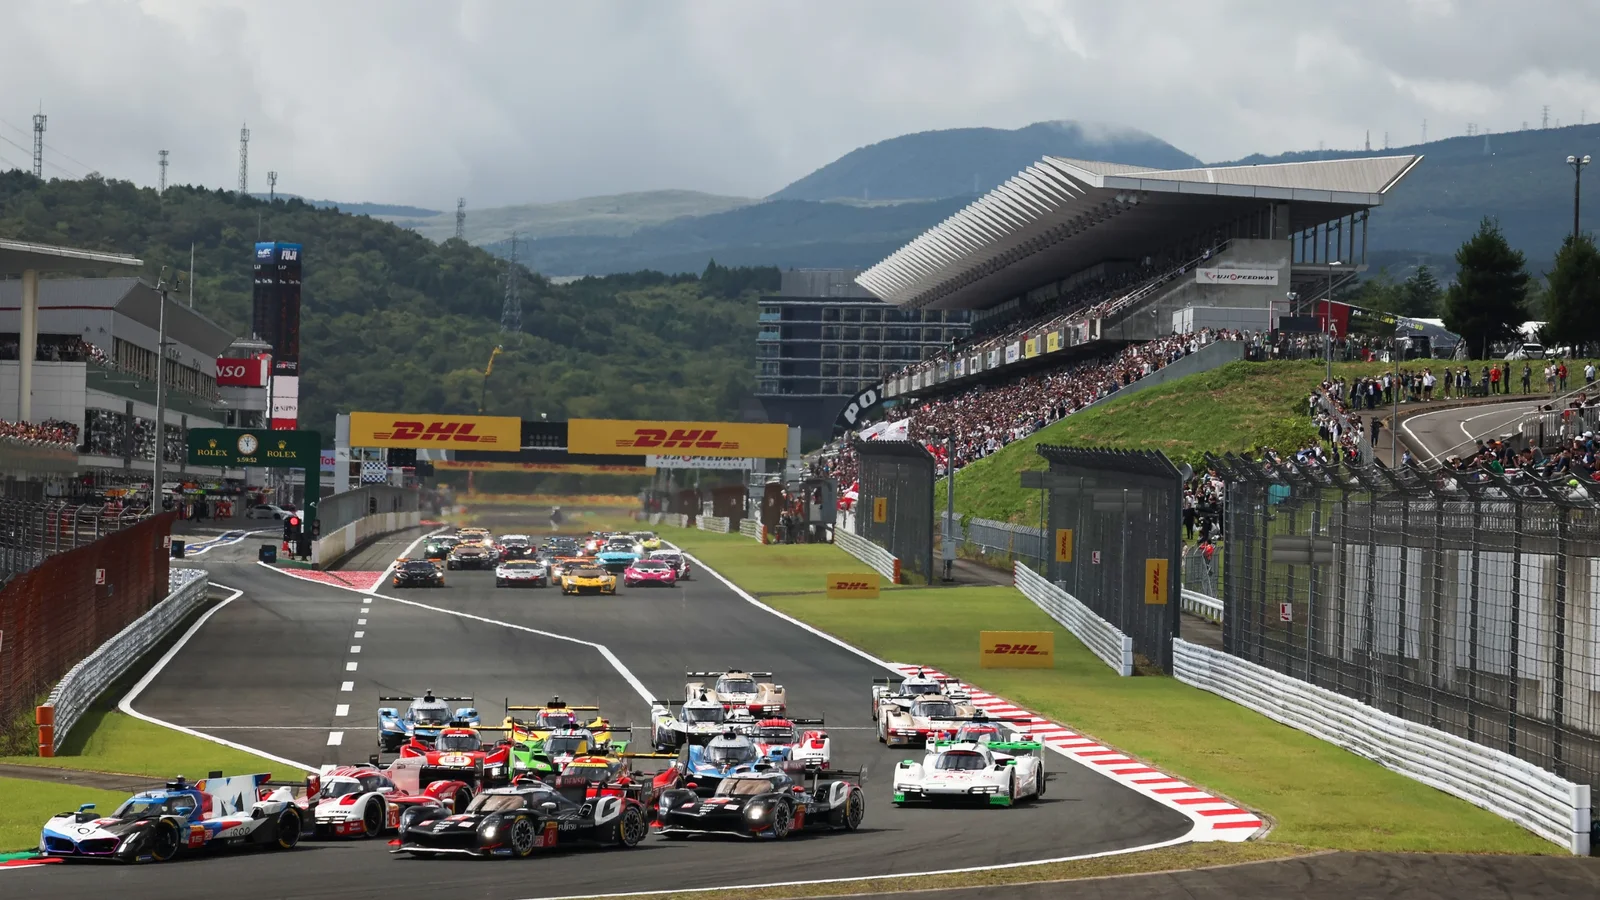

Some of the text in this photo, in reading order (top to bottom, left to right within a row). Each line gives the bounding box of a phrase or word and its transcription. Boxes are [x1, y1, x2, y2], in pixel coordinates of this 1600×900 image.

[281, 250, 297, 260] FUJI
[216, 365, 246, 378] NSO
[390, 421, 480, 442] DHL
[632, 429, 723, 449] DHL
[197, 449, 228, 457] ROLEX
[266, 450, 297, 458] ROLEX
[320, 456, 335, 465] Tot
[836, 582, 869, 590] DHL
[1152, 568, 1160, 595] DHL
[993, 643, 1041, 655] DHL
[391, 811, 397, 826] 6
[230, 827, 251, 837] iQOO
[558, 821, 577, 832] FUJITSU
[191, 835, 203, 843] 15
[548, 829, 554, 844] 8
